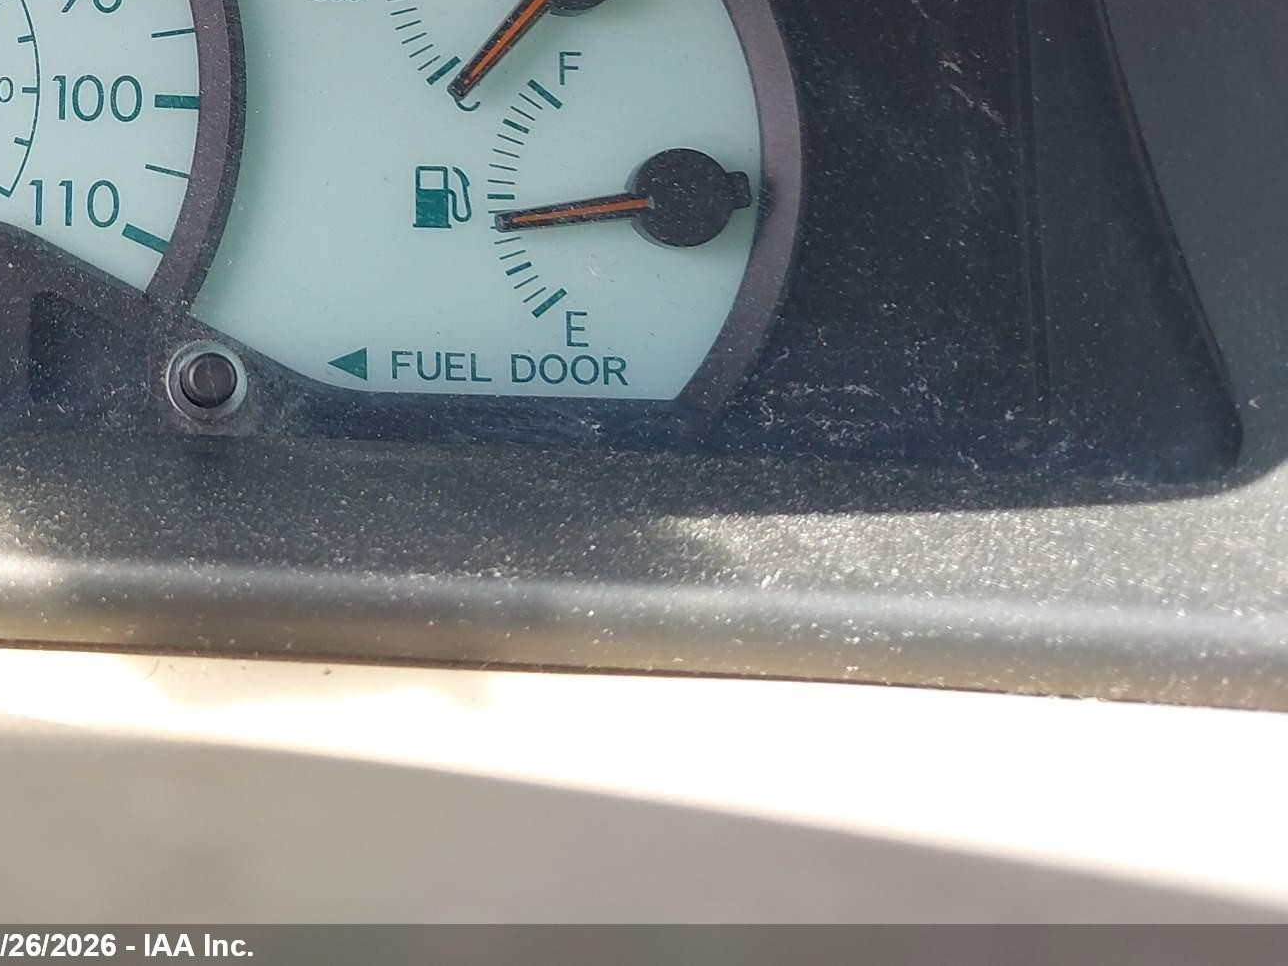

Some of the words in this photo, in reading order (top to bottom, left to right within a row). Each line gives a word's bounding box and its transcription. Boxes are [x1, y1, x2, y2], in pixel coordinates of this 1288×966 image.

[560, 52, 581, 85] F
[51, 75, 142, 122] 100
[30, 180, 118, 227] 110
[565, 311, 588, 346] E
[391, 350, 492, 383] FUEL
[511, 353, 628, 386] DOOR
